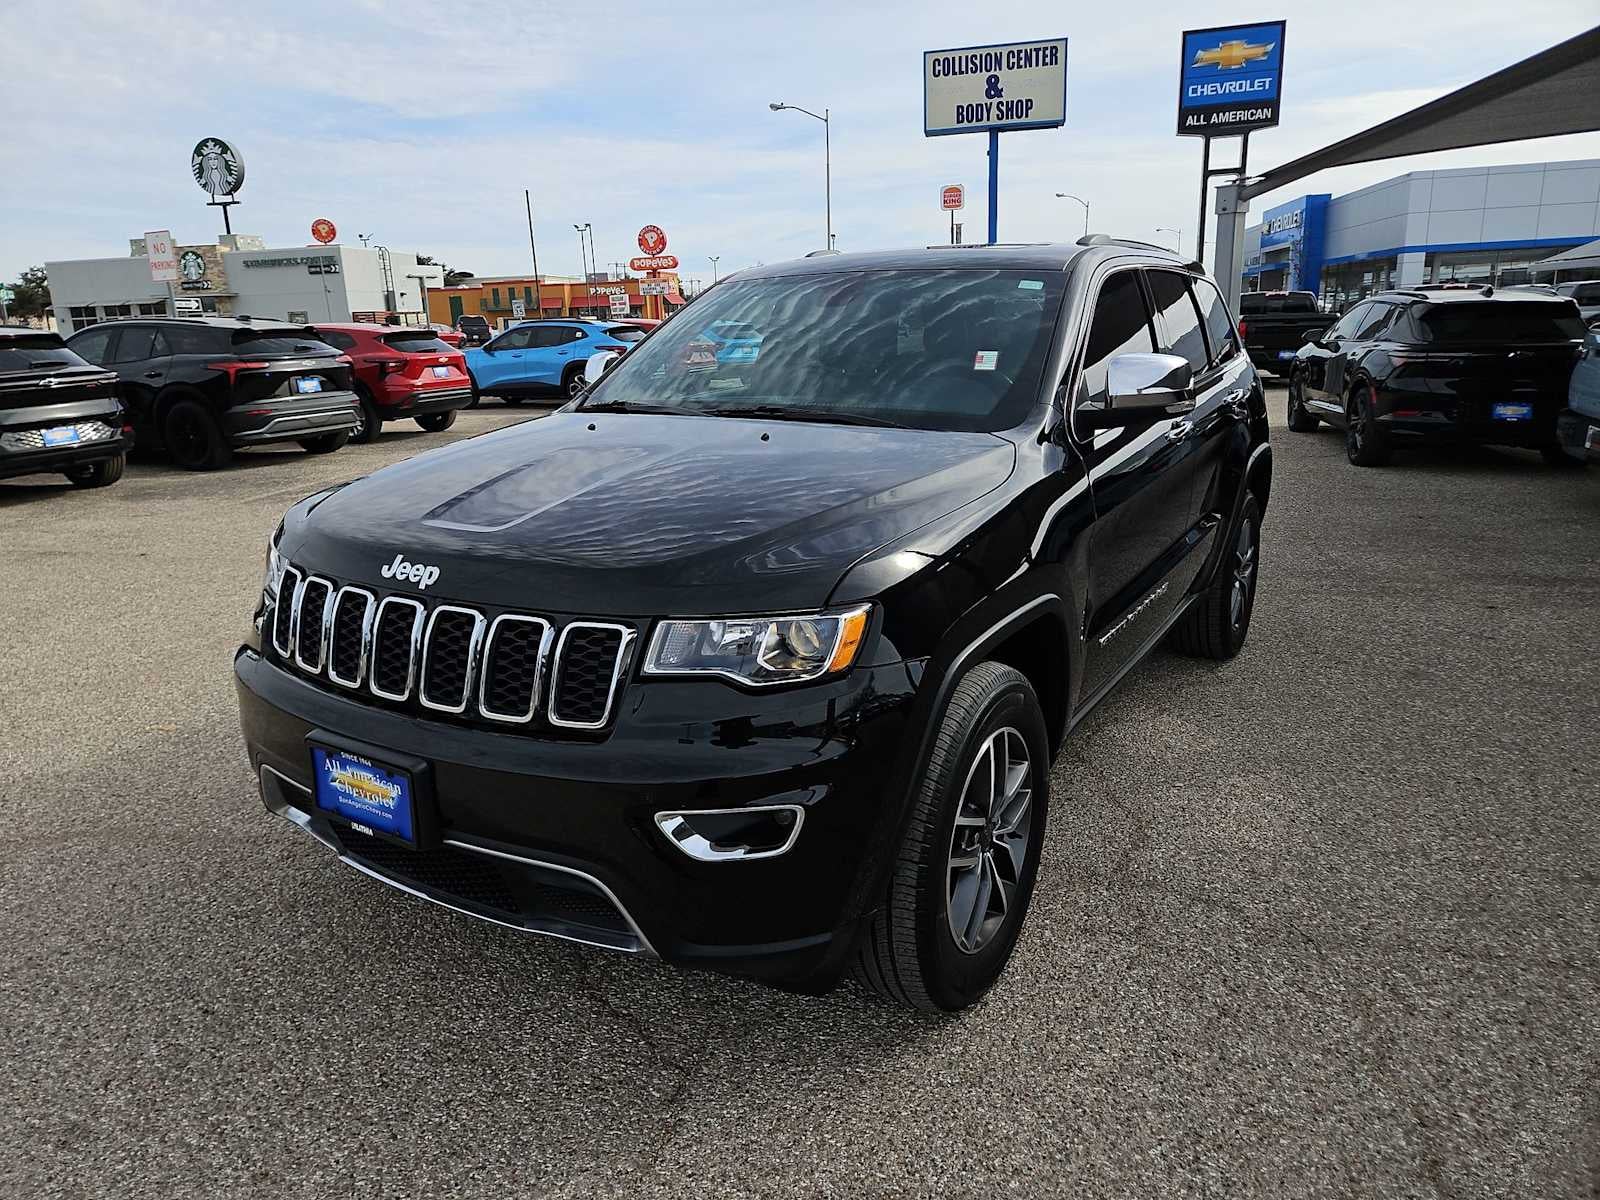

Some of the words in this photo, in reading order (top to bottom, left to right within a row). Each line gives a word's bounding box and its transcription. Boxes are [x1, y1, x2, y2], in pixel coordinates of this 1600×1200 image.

[932, 52, 1003, 78] COLLISION
[1006, 45, 1059, 71] CENTER
[985, 74, 1004, 99] &
[1188, 78, 1272, 97] CHEVROLET
[956, 102, 993, 124] BODY
[996, 98, 1034, 121] SHOP
[1186, 114, 1207, 126] ALL
[1210, 107, 1272, 124] AMERICAN
[1270, 210, 1302, 234] CHEVROLET
[153, 242, 166, 254] NO
[151, 259, 176, 270] PARKING
[381, 554, 440, 590] Jeep
[324, 758, 340, 774] All
[345, 765, 402, 796] American
[335, 778, 395, 810] Chevrolet
